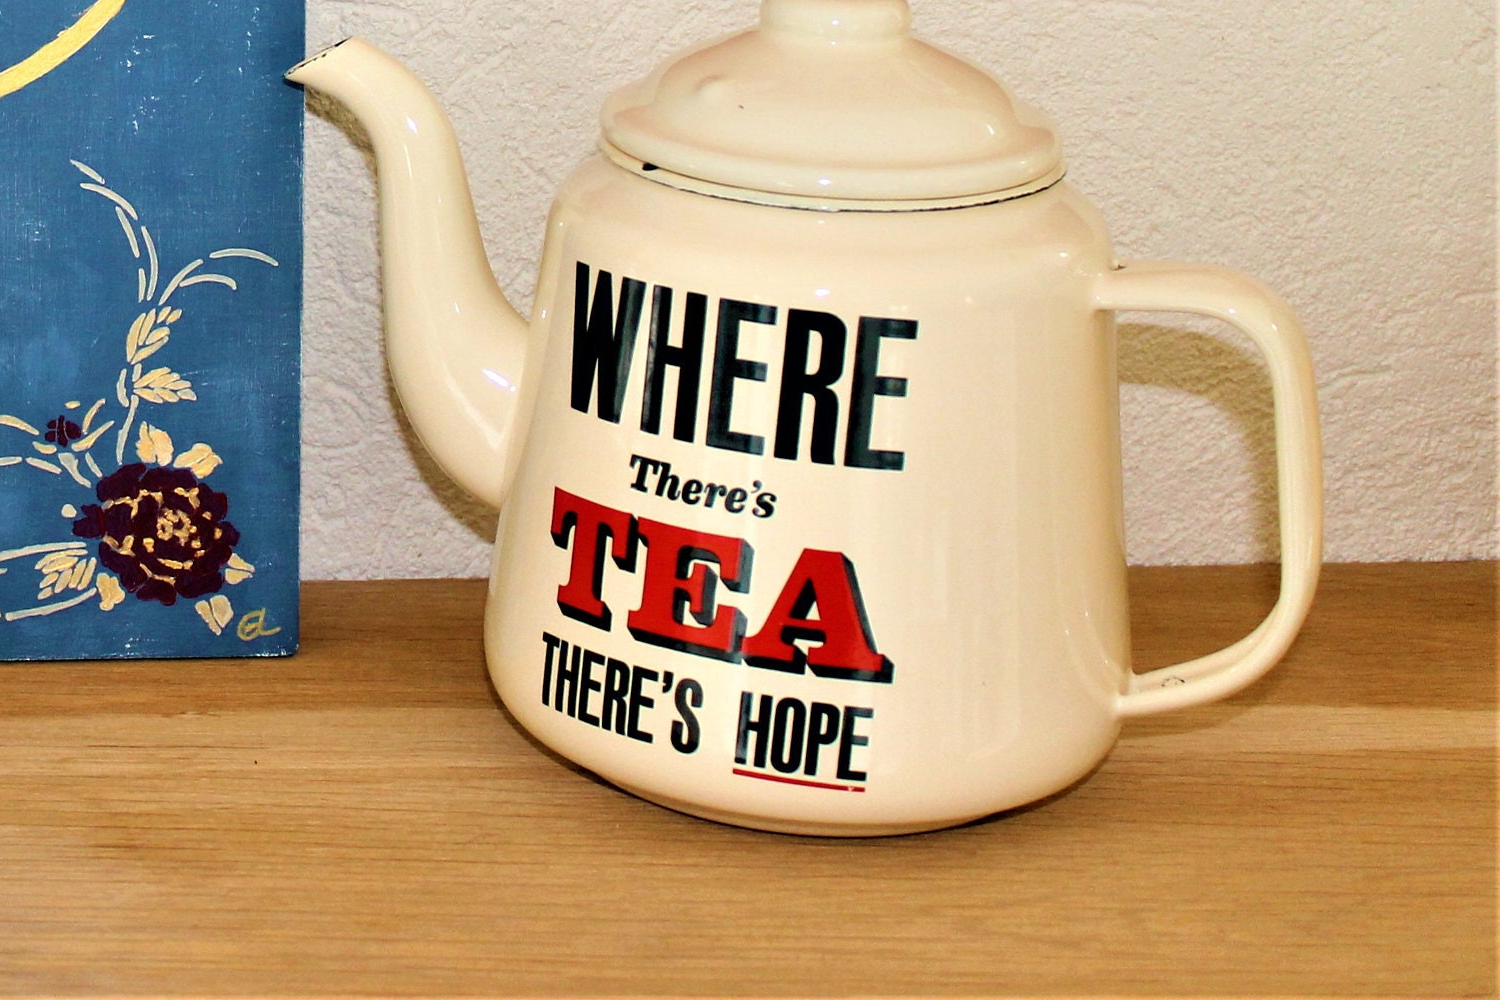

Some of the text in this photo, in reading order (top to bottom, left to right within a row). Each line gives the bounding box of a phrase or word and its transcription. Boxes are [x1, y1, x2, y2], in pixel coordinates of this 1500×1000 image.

[570, 260, 920, 472] WHERE
[628, 453, 778, 519] There's
[550, 485, 895, 684] TEA
[541, 631, 875, 782] THERE'S HOPE
